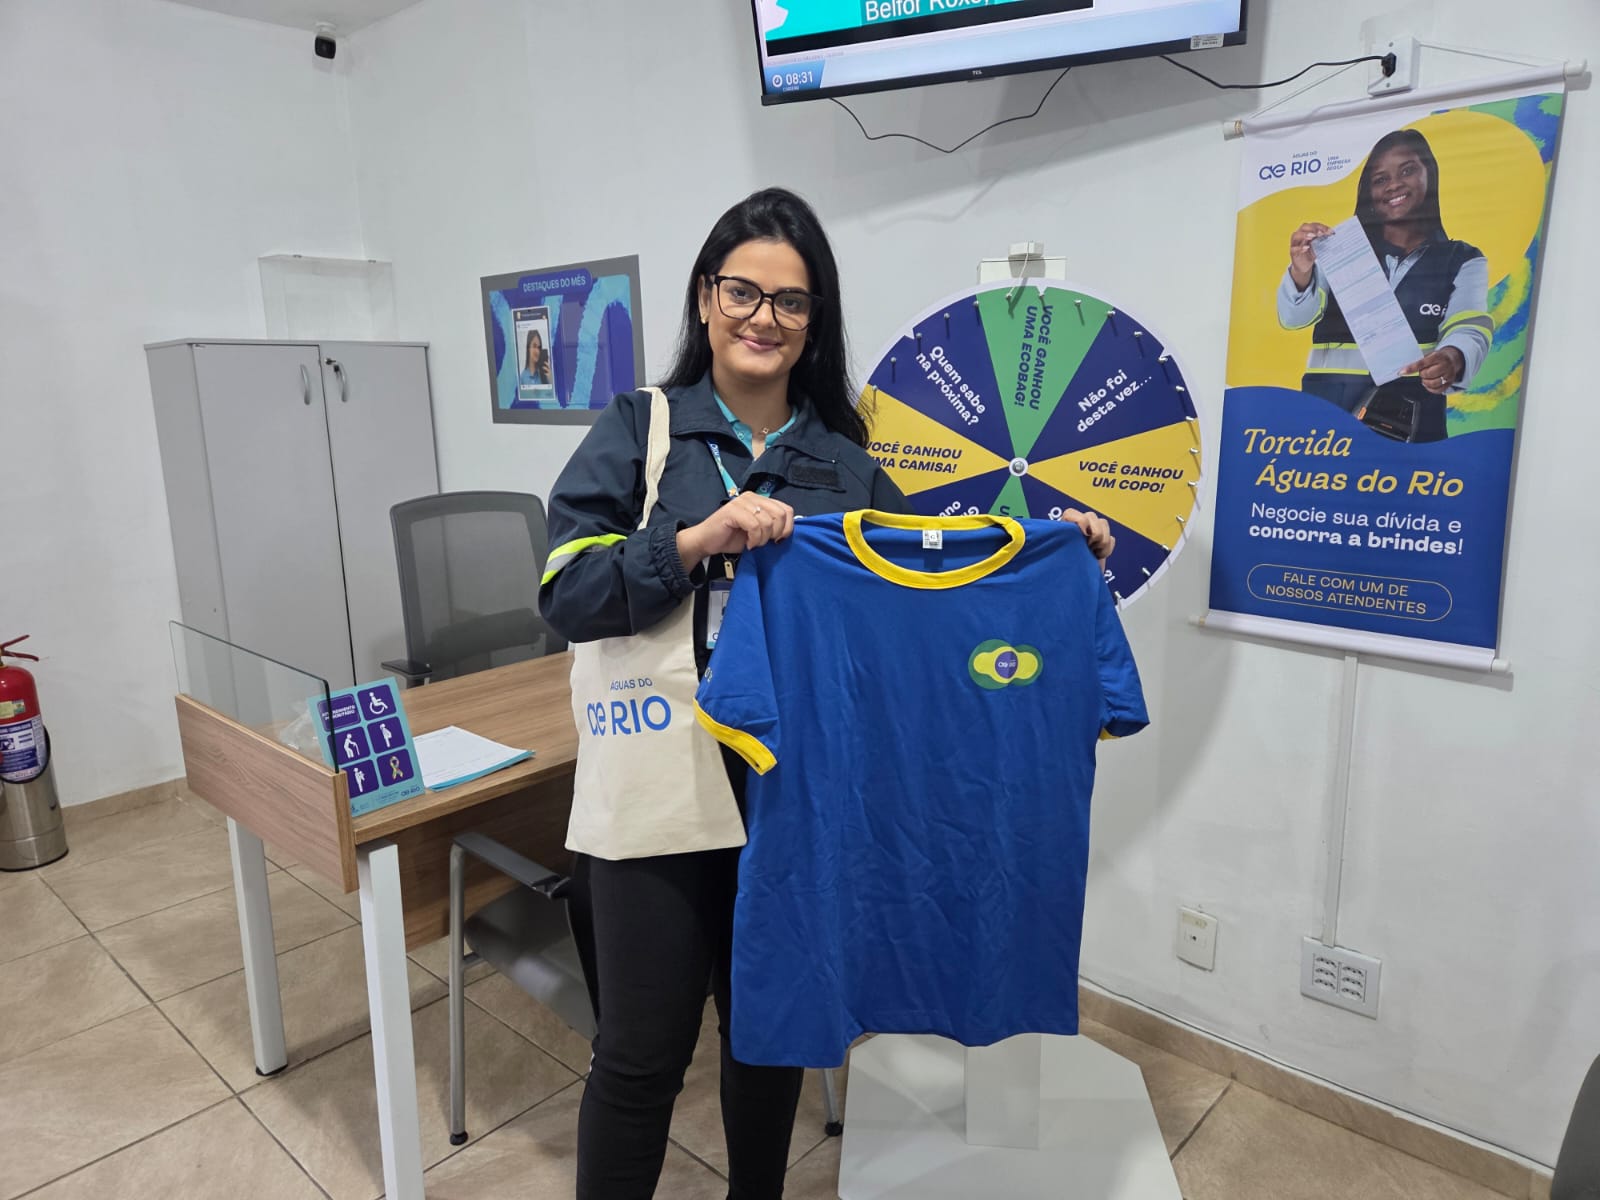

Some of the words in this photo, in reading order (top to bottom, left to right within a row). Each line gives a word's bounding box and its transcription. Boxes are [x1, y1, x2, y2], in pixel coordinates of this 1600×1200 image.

[786, 71, 813, 85] 08:31
[1290, 158, 1321, 176] RIO
[523, 279, 559, 292] DESTAQUES
[560, 277, 570, 288] DO
[1023, 306, 1038, 339] UMA
[1038, 305, 1053, 345] VOCÊ
[915, 353, 931, 372] na
[927, 370, 979, 426] próxima?
[929, 346, 962, 384] Quem
[960, 384, 985, 414] sabe
[1014, 342, 1032, 407] ECOBAG!
[1029, 347, 1047, 410] GANHOU
[1077, 401, 1116, 432] desta
[1115, 376, 1152, 402] vez...
[1078, 388, 1107, 412] Não
[1106, 369, 1127, 390] foi
[902, 445, 962, 459] GANHOU
[1243, 428, 1353, 457] Torcida
[899, 459, 957, 474] CAMISA!
[1079, 461, 1118, 474] VOCÊ
[1120, 465, 1184, 479] GANHOU
[1255, 458, 1348, 494] Águas
[1356, 469, 1398, 494] do
[1407, 470, 1464, 497] Rio
[1092, 477, 1117, 488] UM
[1119, 479, 1165, 493] COPO!
[1251, 502, 1327, 524] Negocie
[1332, 512, 1369, 527] sua
[1375, 511, 1440, 532] dívida
[1448, 519, 1462, 533] e
[1249, 525, 1342, 545] concorra
[1348, 533, 1361, 547] a
[1367, 531, 1464, 556] brindes!
[1265, 584, 1324, 602] NOSSOS
[1327, 592, 1427, 614] ATENDENTES
[1283, 572, 1316, 586] FALE
[1320, 576, 1355, 591] COM
[1359, 580, 1384, 594] UM
[1388, 584, 1409, 597] DE
[638, 677, 653, 687] DO
[611, 695, 671, 735] RIO
